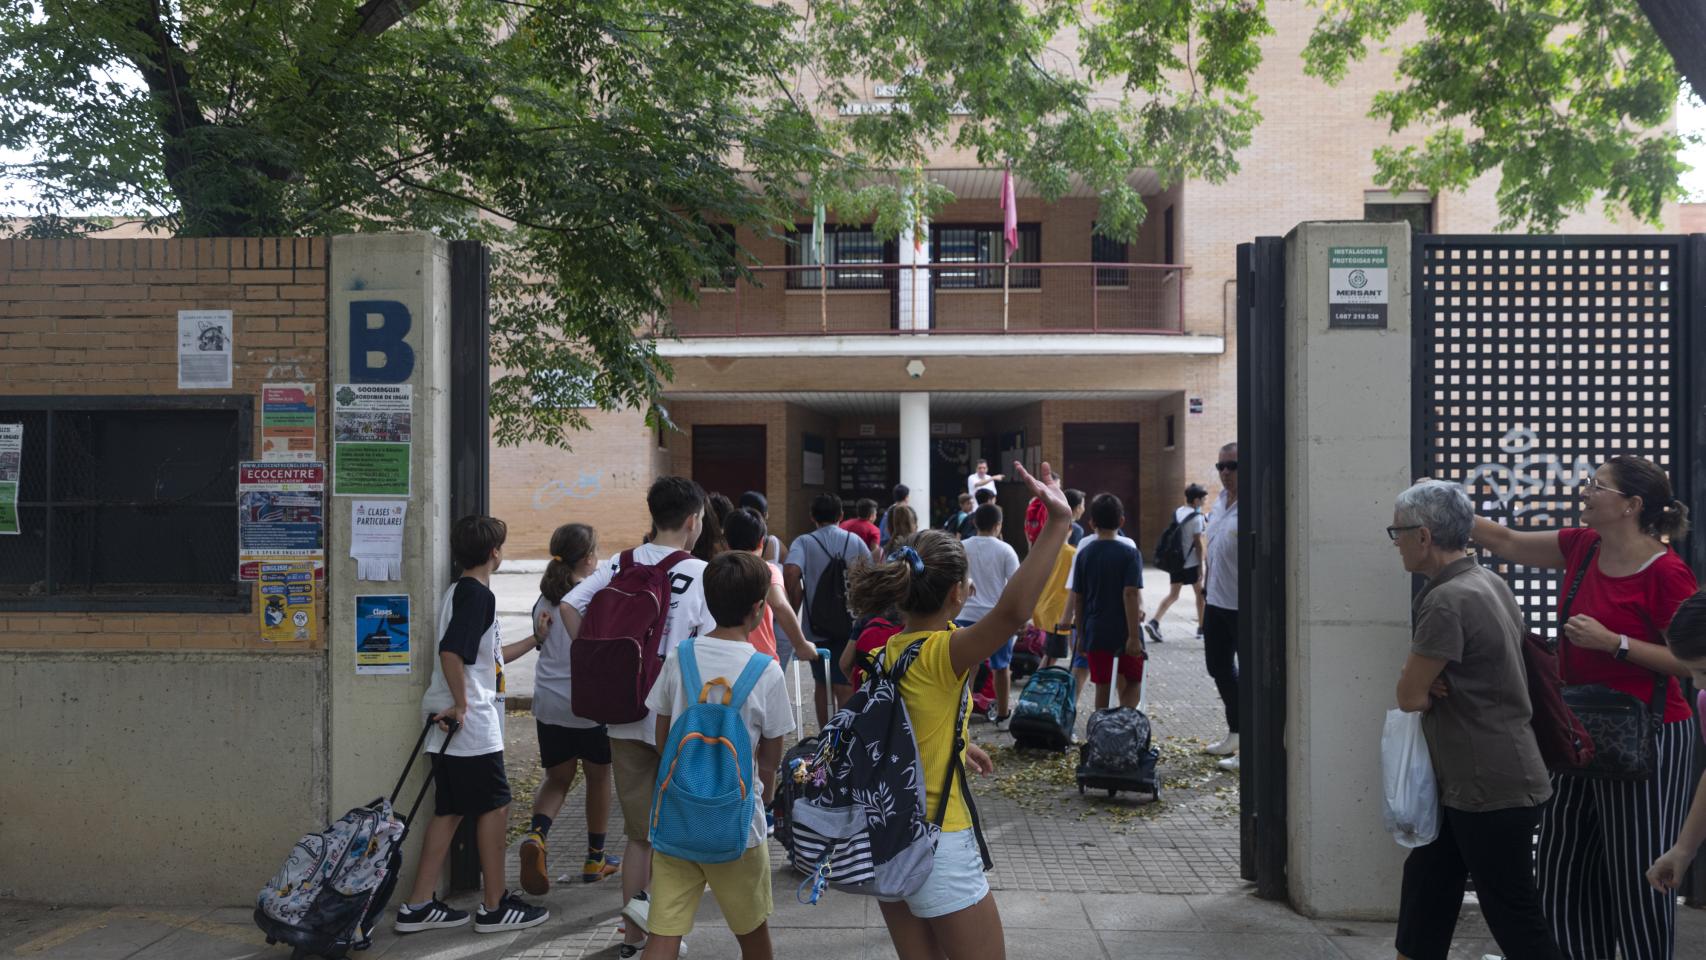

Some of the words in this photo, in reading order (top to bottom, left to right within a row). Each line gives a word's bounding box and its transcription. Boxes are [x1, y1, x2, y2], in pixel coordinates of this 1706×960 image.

[349, 301, 415, 384] B
[247, 469, 315, 479] ECOCENTRE
[368, 508, 390, 516] CLASES
[356, 517, 402, 526] PARTICULARES
[372, 608, 393, 616] Clases
